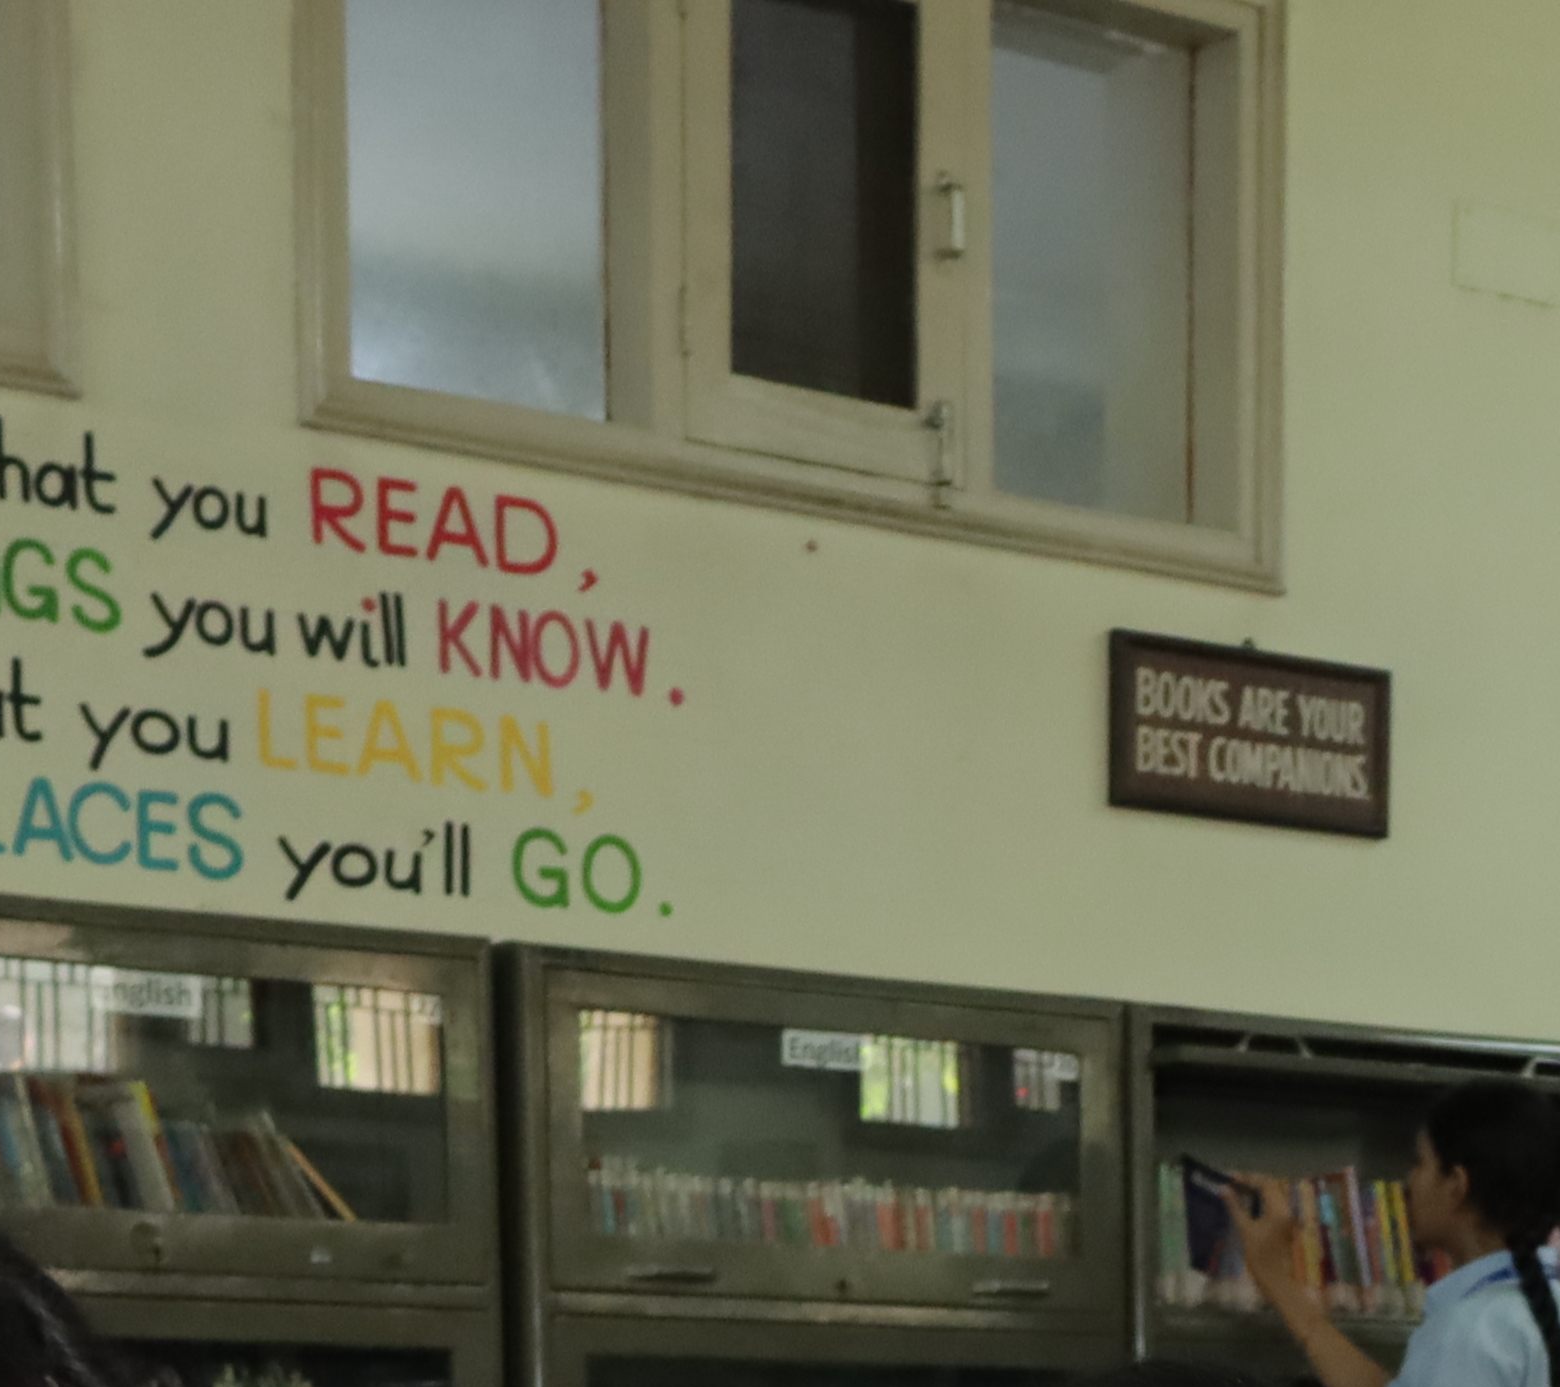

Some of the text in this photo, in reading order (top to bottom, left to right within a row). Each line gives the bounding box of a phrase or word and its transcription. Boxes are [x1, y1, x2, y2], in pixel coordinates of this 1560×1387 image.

[150, 475, 268, 541] you
[308, 466, 599, 594] READ,
[143, 591, 278, 659] you
[297, 591, 407, 669] will
[437, 598, 685, 709] KNOW.
[78, 701, 230, 772] you
[255, 686, 595, 817] LEARN,
[1134, 665, 1367, 746] BOOKS ARE YOUR
[1134, 724, 1203, 780] BEST
[277, 819, 472, 902] you'll
[510, 826, 674, 917] GO.
[102, 978, 193, 1009] nglish
